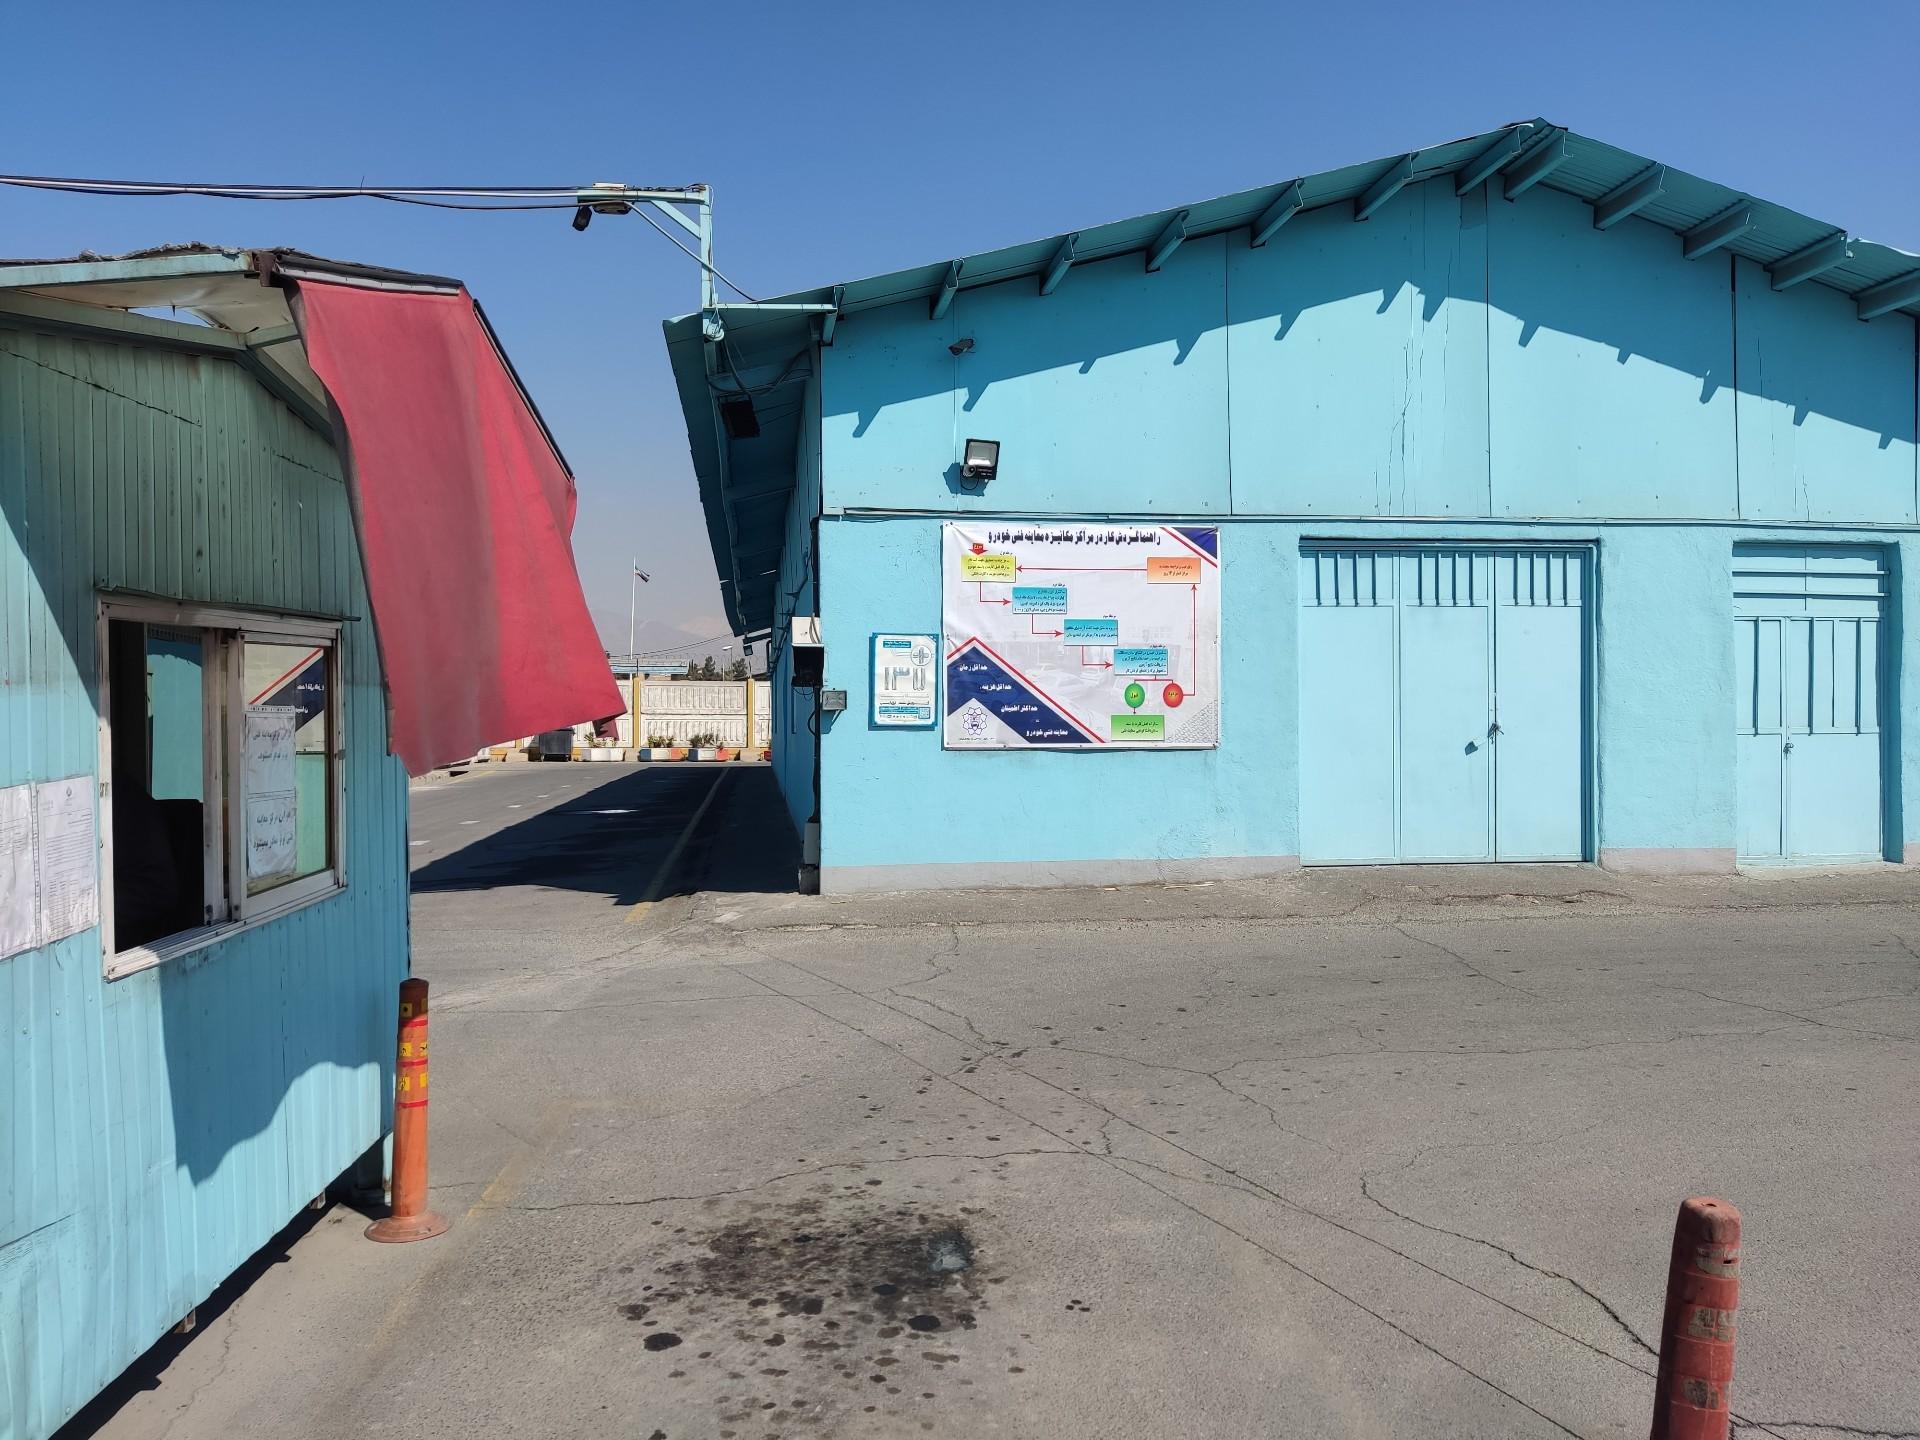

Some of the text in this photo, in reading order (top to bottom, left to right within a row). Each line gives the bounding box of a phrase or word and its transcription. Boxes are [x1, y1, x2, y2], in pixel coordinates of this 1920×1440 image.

[988, 528, 1160, 546] راهنما گردش کار در مراکز مکانیزه معاینه فنی خودرو
[972, 664, 988, 672] حداقل
[1000, 704, 1038, 712] حداکثر اطمینان
